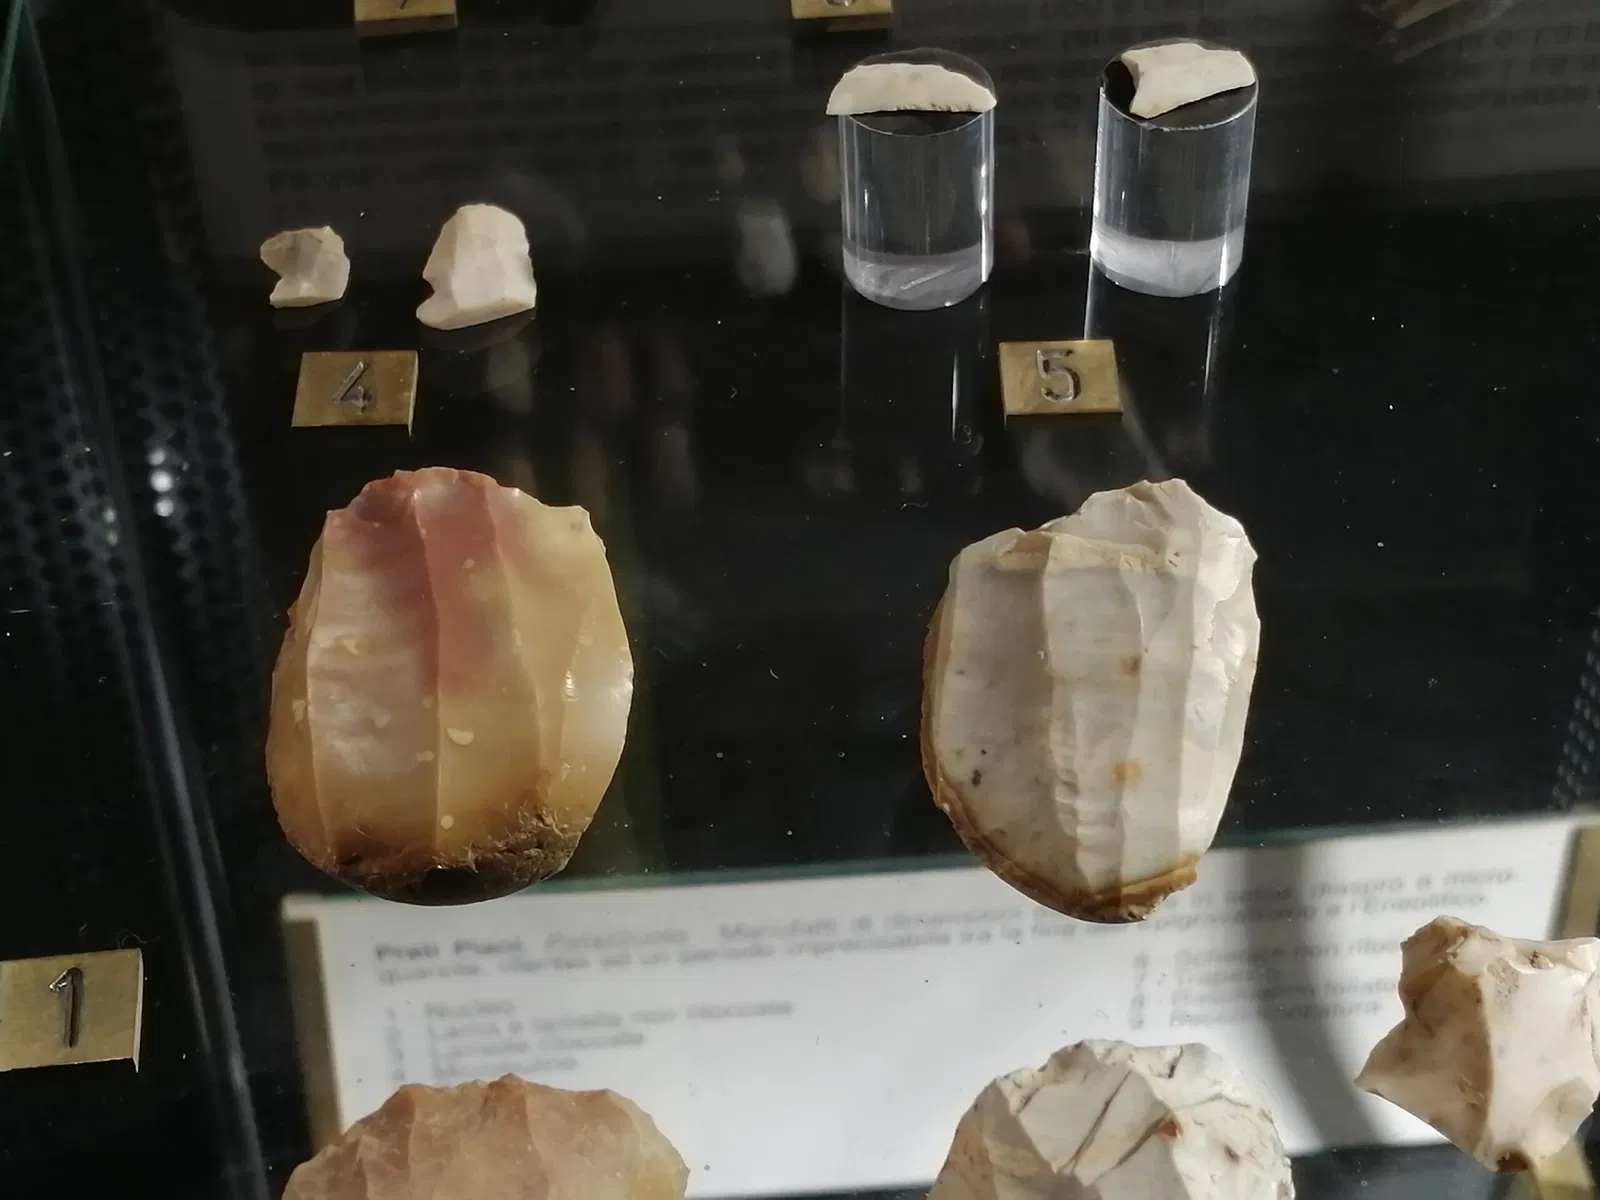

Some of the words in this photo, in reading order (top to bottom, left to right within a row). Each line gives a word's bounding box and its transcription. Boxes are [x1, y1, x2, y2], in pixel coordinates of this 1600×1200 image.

[333, 361, 371, 414] 4
[1037, 349, 1081, 403] 5
[49, 966, 83, 1048] 1
